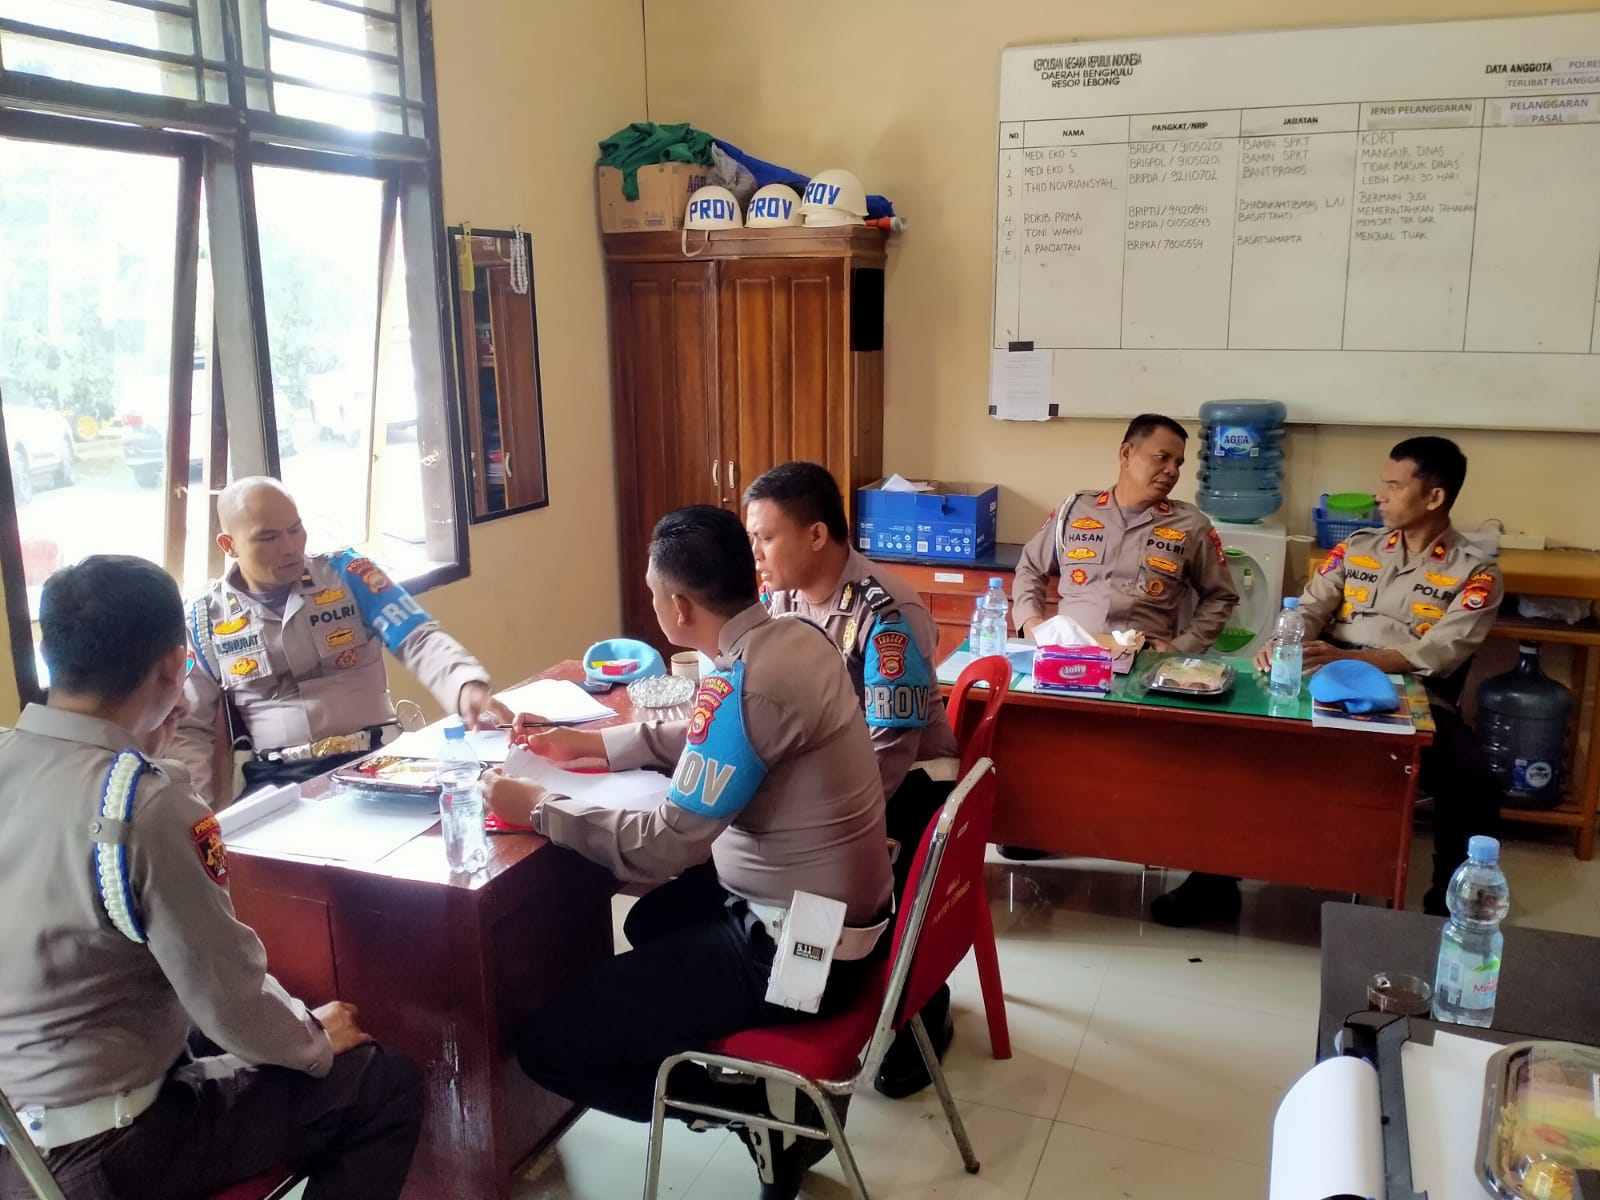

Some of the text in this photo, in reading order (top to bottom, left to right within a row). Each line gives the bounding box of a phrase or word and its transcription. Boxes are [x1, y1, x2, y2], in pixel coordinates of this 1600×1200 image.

[1065, 56, 1087, 70] NEGARA
[1112, 53, 1142, 67] INDONESIA
[1485, 64, 1508, 74] DATA
[1510, 62, 1552, 73] ANGGOTA
[1041, 68, 1133, 80] DAERAH BENGKULU
[1051, 77, 1120, 88] RESOR LEBONG
[1507, 78, 1549, 87] TERLIBAT
[1370, 103, 1472, 116] JENIS PELANGGARAN
[1510, 99, 1589, 110] PELANGGARAN
[1532, 114, 1564, 123] PASAL
[1062, 129, 1085, 137] NAMA
[1361, 131, 1397, 146] KDRT
[1283, 136, 1312, 148] SPKT
[1025, 150, 1044, 160] MEDI
[1048, 150, 1065, 159] EKO
[1282, 150, 1309, 160] SPKT
[1024, 166, 1043, 176] MEDI
[1046, 165, 1063, 175] EKO
[689, 198, 735, 223] PROV
[748, 197, 793, 222] PROV
[1055, 212, 1082, 223] PRIMA
[1024, 228, 1047, 238] TONI
[1224, 435, 1249, 445] AQUA
[1068, 533, 1104, 543] HASAN
[1146, 538, 1185, 556] POLRI
[309, 605, 356, 627] POLRI
[864, 685, 929, 720] PROV
[671, 750, 737, 807] OV
